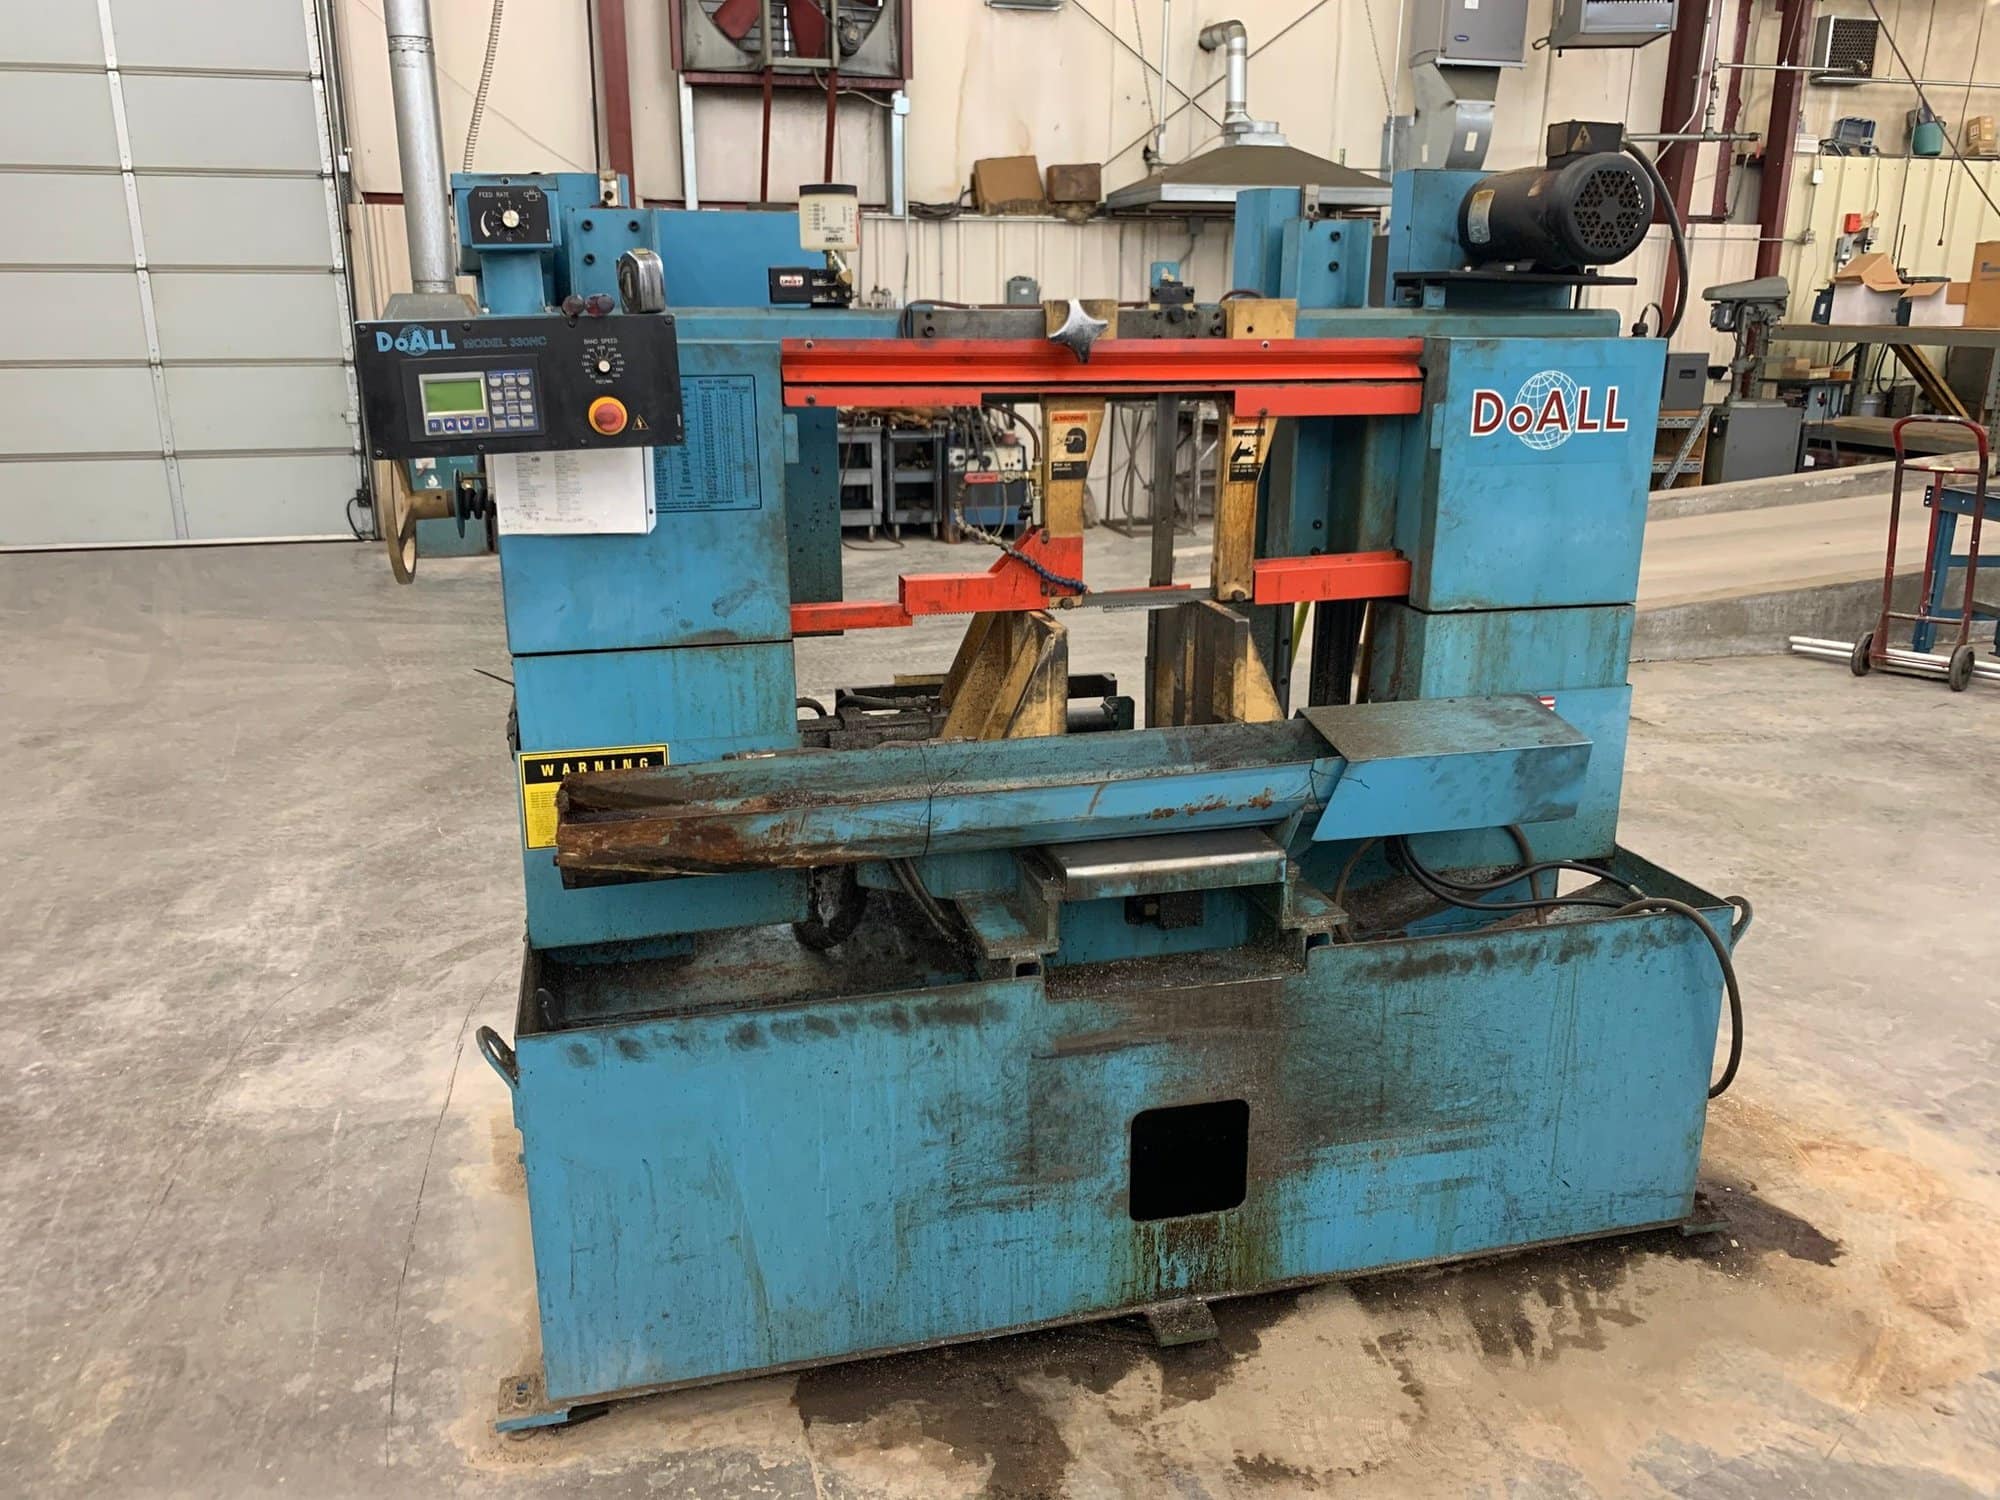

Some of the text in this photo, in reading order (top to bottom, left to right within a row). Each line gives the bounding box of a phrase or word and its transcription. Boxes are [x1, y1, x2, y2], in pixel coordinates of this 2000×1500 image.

[376, 329, 456, 353] DoALL
[1470, 386, 1629, 437] DoALL
[540, 757, 650, 777] WARNING
